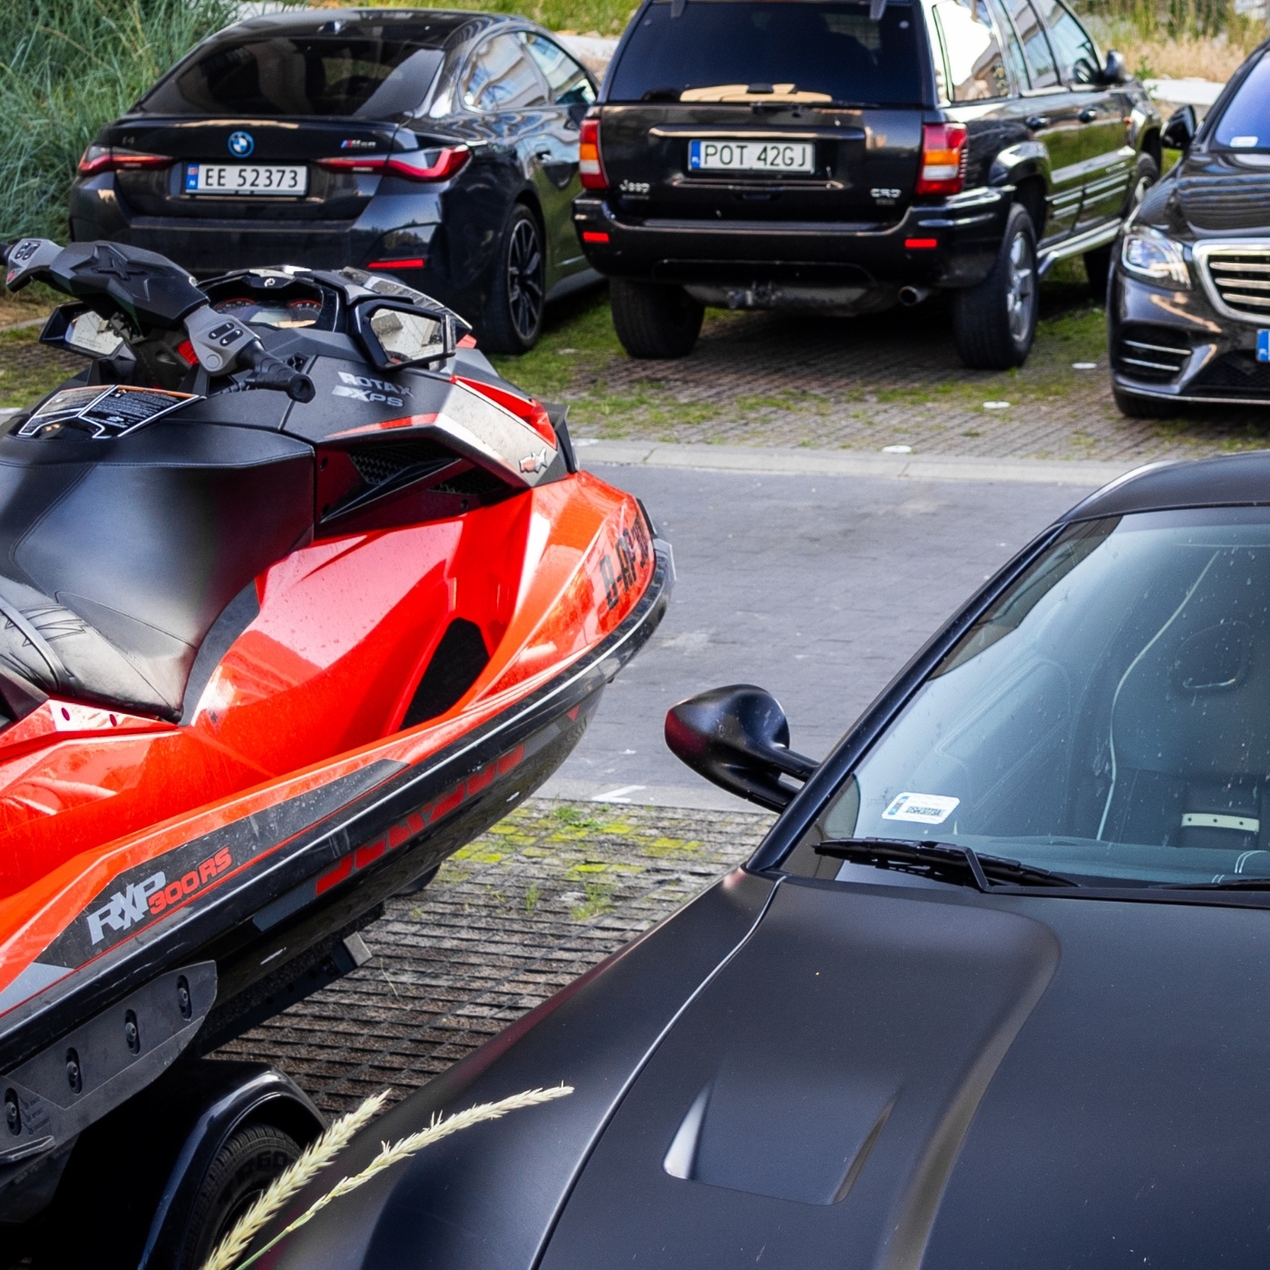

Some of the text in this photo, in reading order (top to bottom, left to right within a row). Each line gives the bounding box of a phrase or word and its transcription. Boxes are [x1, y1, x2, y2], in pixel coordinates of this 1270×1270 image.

[703, 144, 807, 168] POT 42GJ
[204, 167, 299, 189] EE 52373
[337, 371, 415, 398] ROTAX
[344, 387, 404, 408] XPS
[86, 870, 167, 946] RXP
